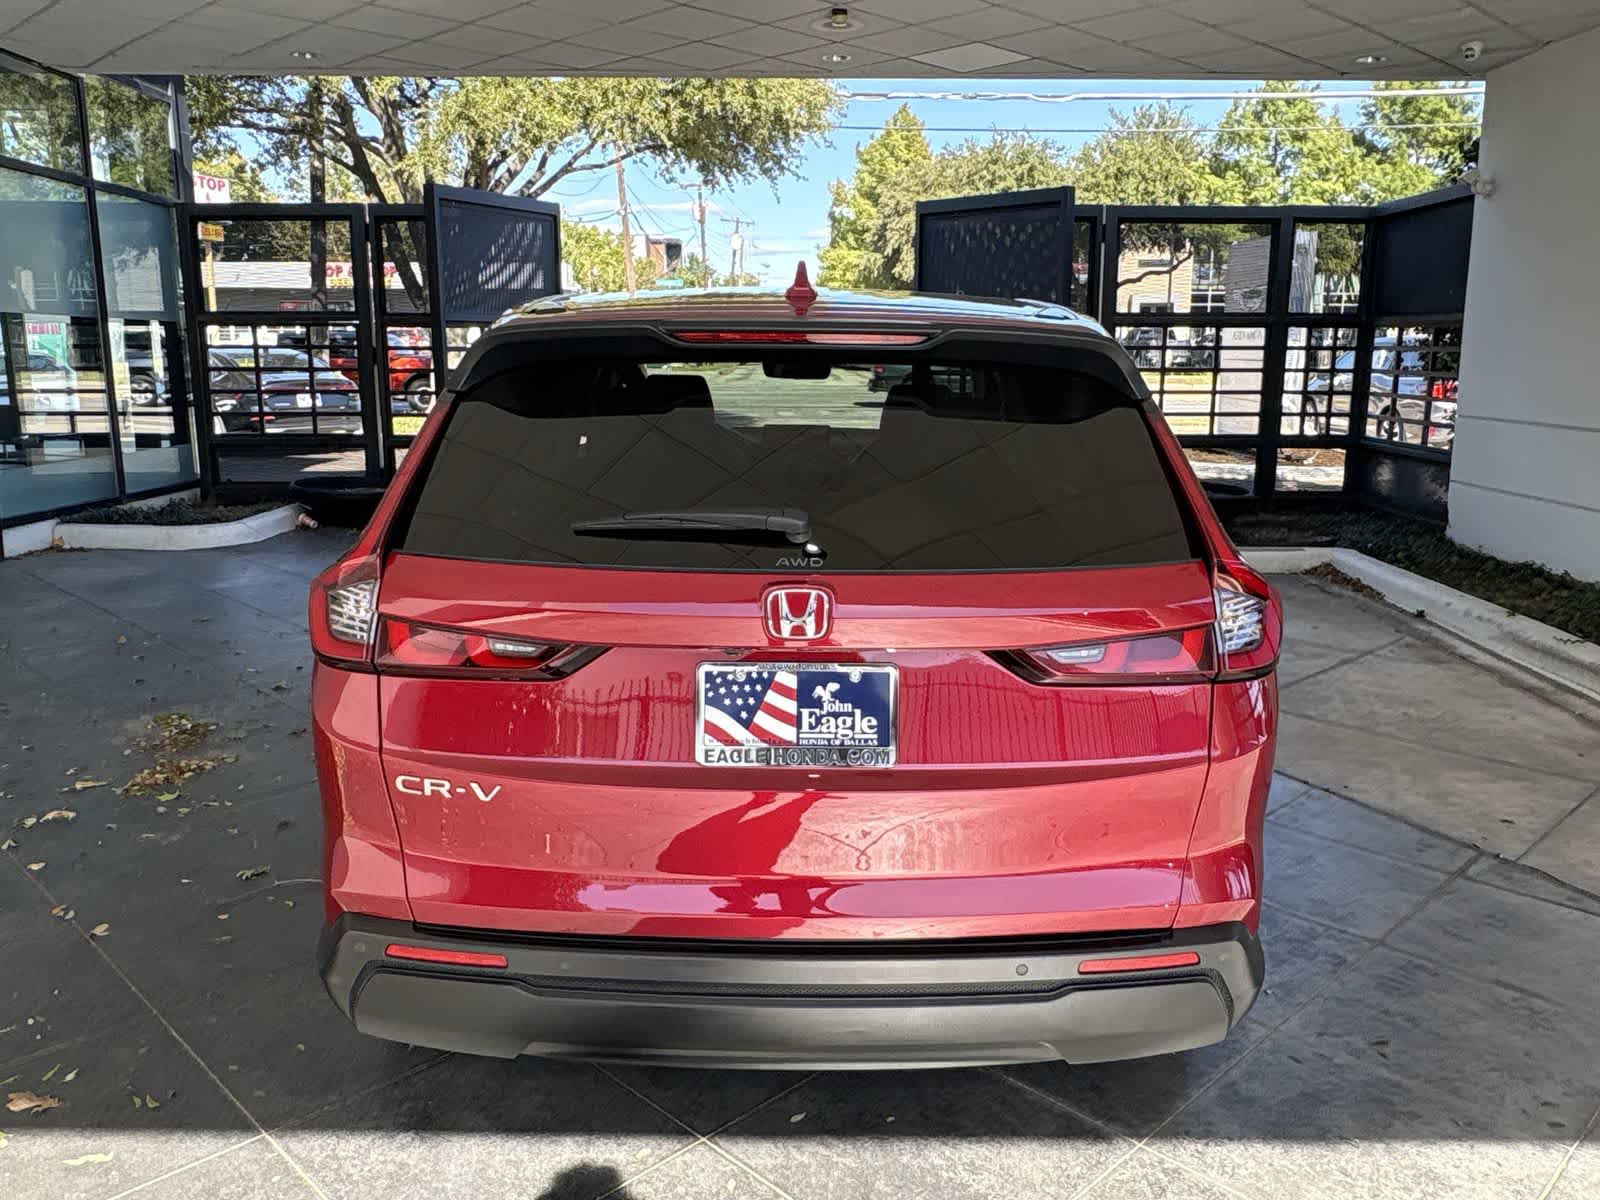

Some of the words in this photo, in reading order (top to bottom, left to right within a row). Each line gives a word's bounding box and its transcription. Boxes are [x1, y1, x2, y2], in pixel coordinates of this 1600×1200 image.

[775, 557, 824, 568] AWD
[799, 708, 878, 740] Eagle
[395, 775, 502, 802] CR-V
